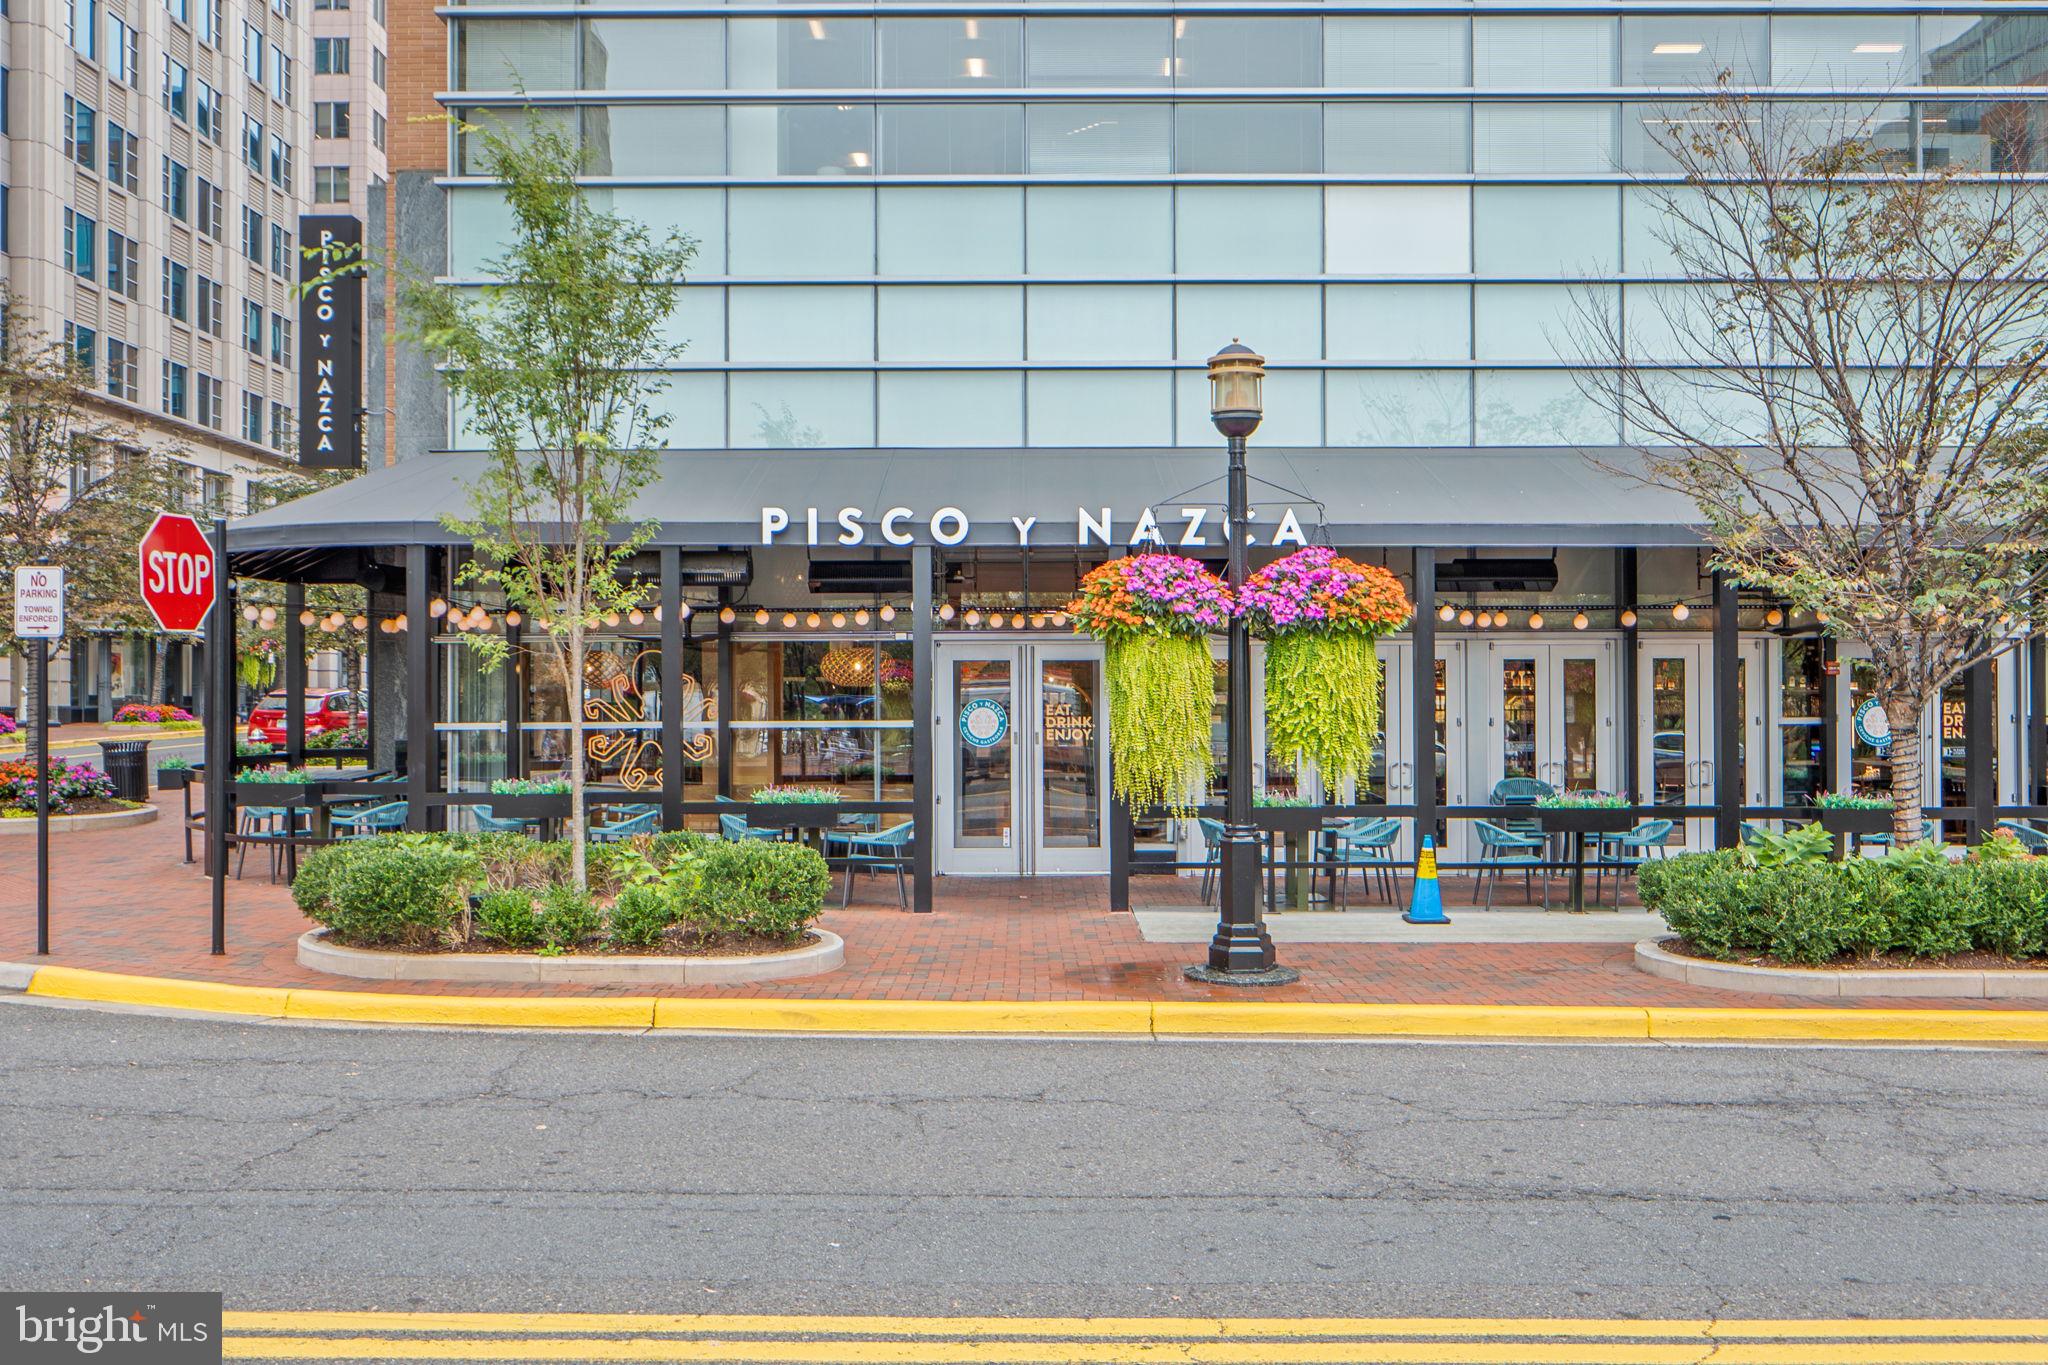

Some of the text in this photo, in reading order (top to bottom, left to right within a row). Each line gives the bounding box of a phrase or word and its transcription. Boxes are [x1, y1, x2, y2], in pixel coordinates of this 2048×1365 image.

[319, 334, 332, 347] Y
[316, 359, 334, 451] NAZCA
[761, 507, 970, 546] PISCO
[1011, 516, 1037, 546] Y
[148, 550, 211, 596] STOP
[30, 575, 47, 587] NO
[20, 589, 58, 599] PARKING
[19, 615, 58, 623] ENFORCED
[961, 702, 978, 722] PISCO
[984, 701, 1005, 722] NAZCA
[1045, 704, 1074, 716] EAT.
[1856, 701, 1874, 721] PISCO
[1045, 716, 1096, 728] DRINK.
[1046, 728, 1094, 741] ENJOY.
